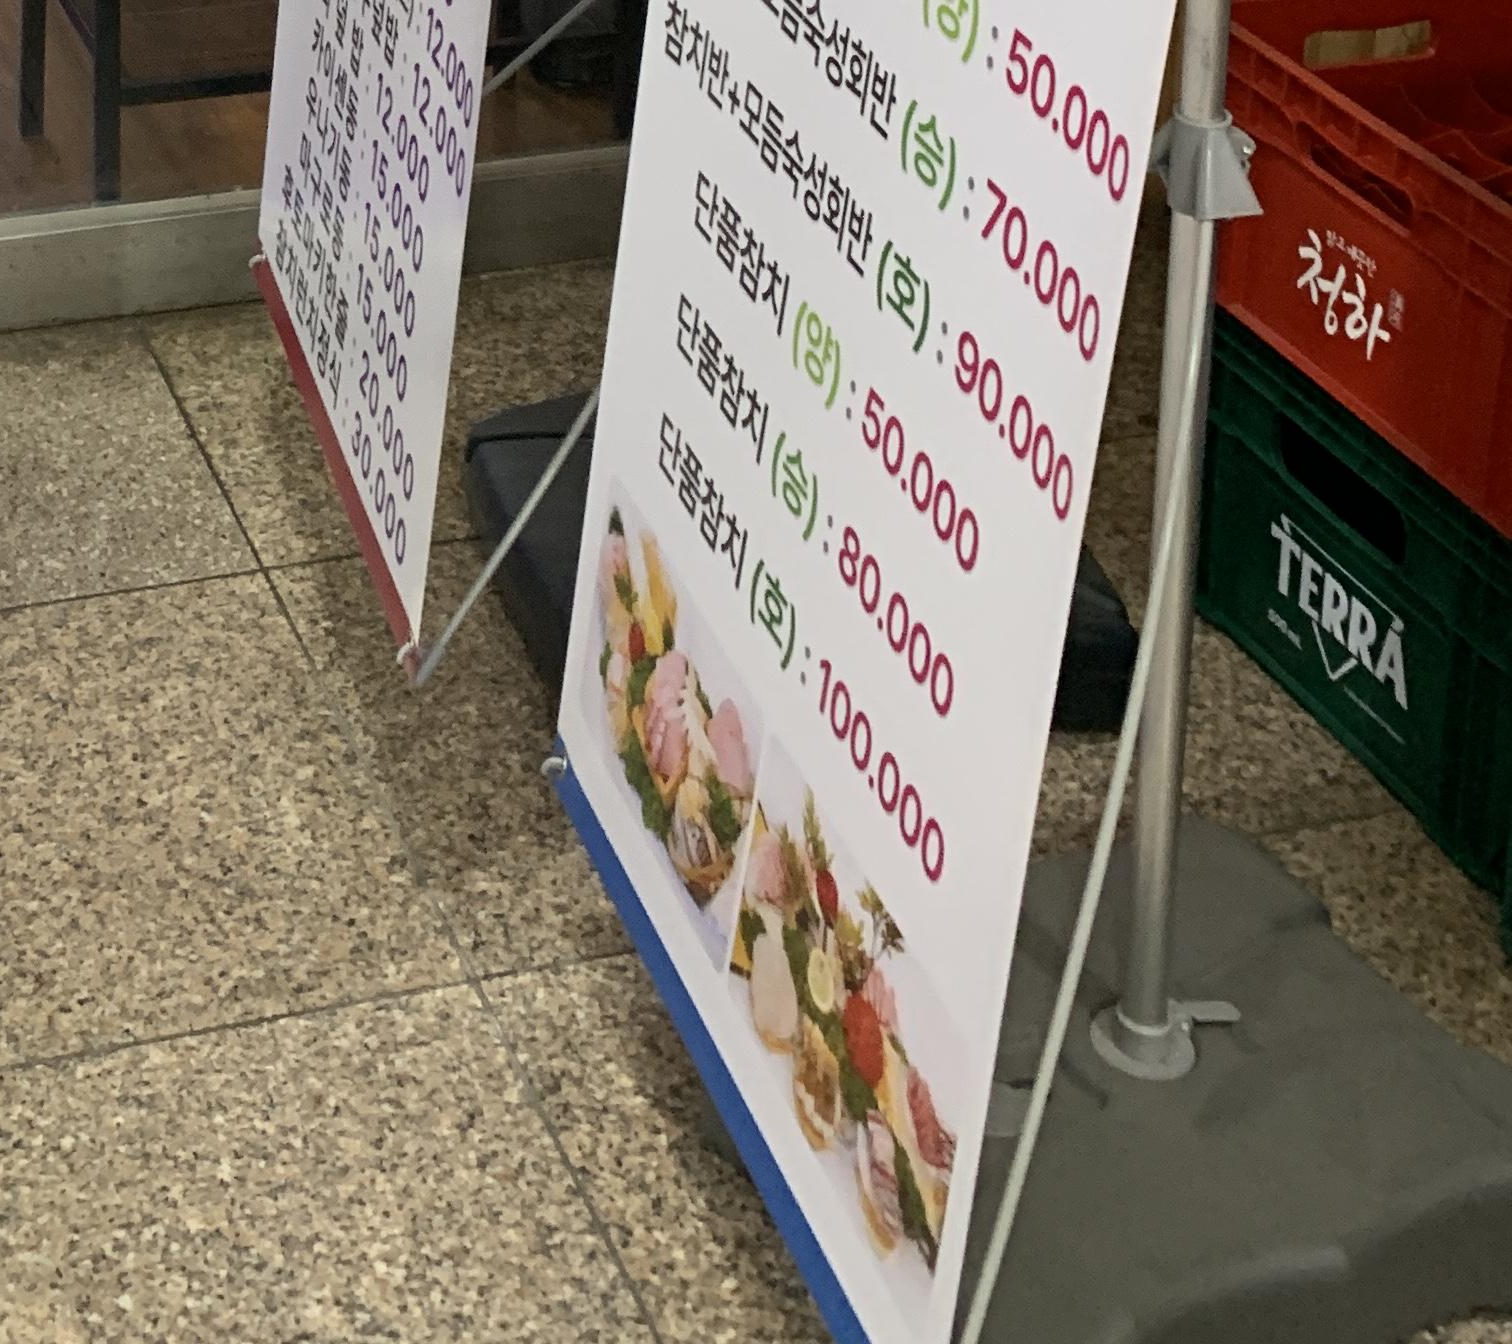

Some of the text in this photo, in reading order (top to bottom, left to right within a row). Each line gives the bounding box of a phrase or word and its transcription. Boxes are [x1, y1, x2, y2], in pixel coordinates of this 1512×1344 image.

[375, 71, 430, 203] 12.000
[411, 61, 466, 198] 12.000
[425, 6, 473, 129] 12.000
[1005, 28, 1129, 202] 50.000
[363, 201, 416, 338] 15.000
[370, 138, 424, 273] 15.000
[980, 178, 1100, 361] 70.000
[356, 262, 408, 402] 15.000
[1297, 228, 1391, 360] 청하
[350, 409, 406, 566] 30.000
[358, 349, 414, 501] 20.000
[861, 386, 979, 572] 50.000
[954, 330, 1073, 521] 90.000
[658, 412, 748, 588] 단품참치
[818, 659, 944, 882] 100.000
[837, 525, 954, 717] 80.000
[1271, 519, 1408, 710] TERRA
